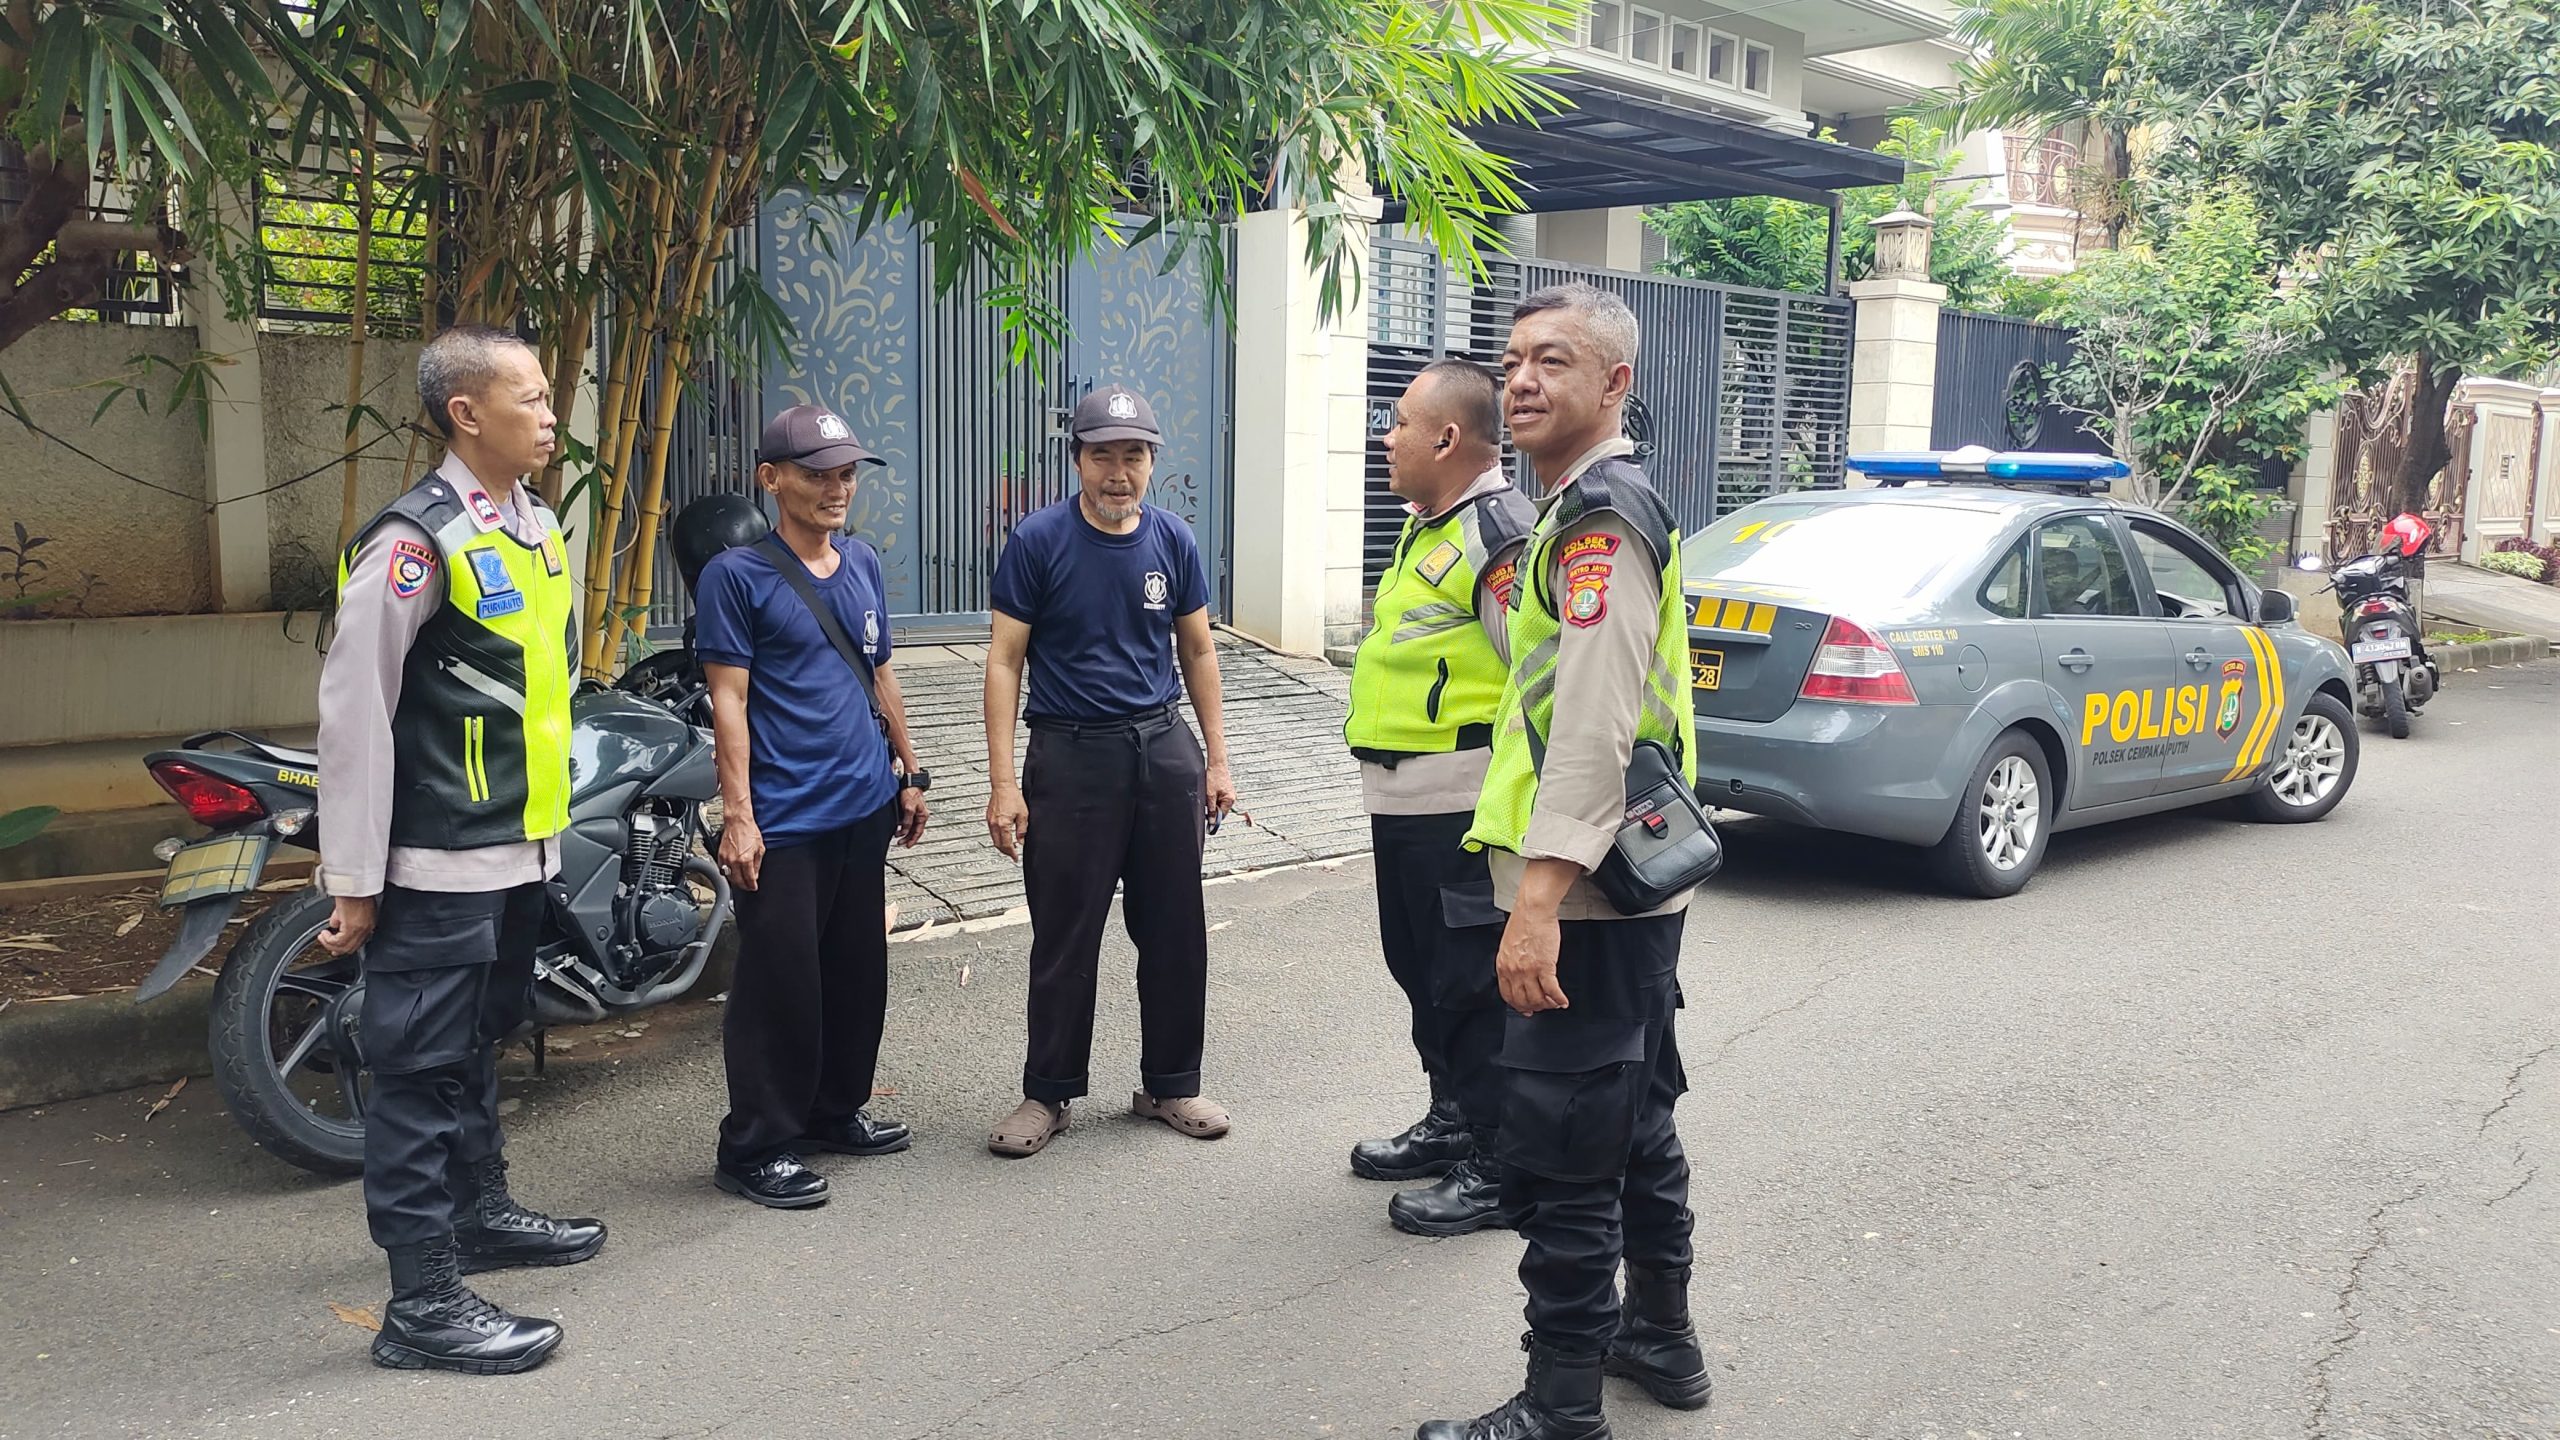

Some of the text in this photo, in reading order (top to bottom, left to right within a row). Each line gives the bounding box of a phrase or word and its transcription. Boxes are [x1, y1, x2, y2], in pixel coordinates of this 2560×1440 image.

[1372, 408, 1391, 429] 20
[1564, 536, 1607, 555] POLSEK
[1889, 628, 1959, 643] CALL CENTER 110
[1912, 643, 1944, 657] SMS 110
[2081, 684, 2210, 746] POLISI
[2092, 741, 2190, 766] POLSEK CEMPAKA PUTIH
